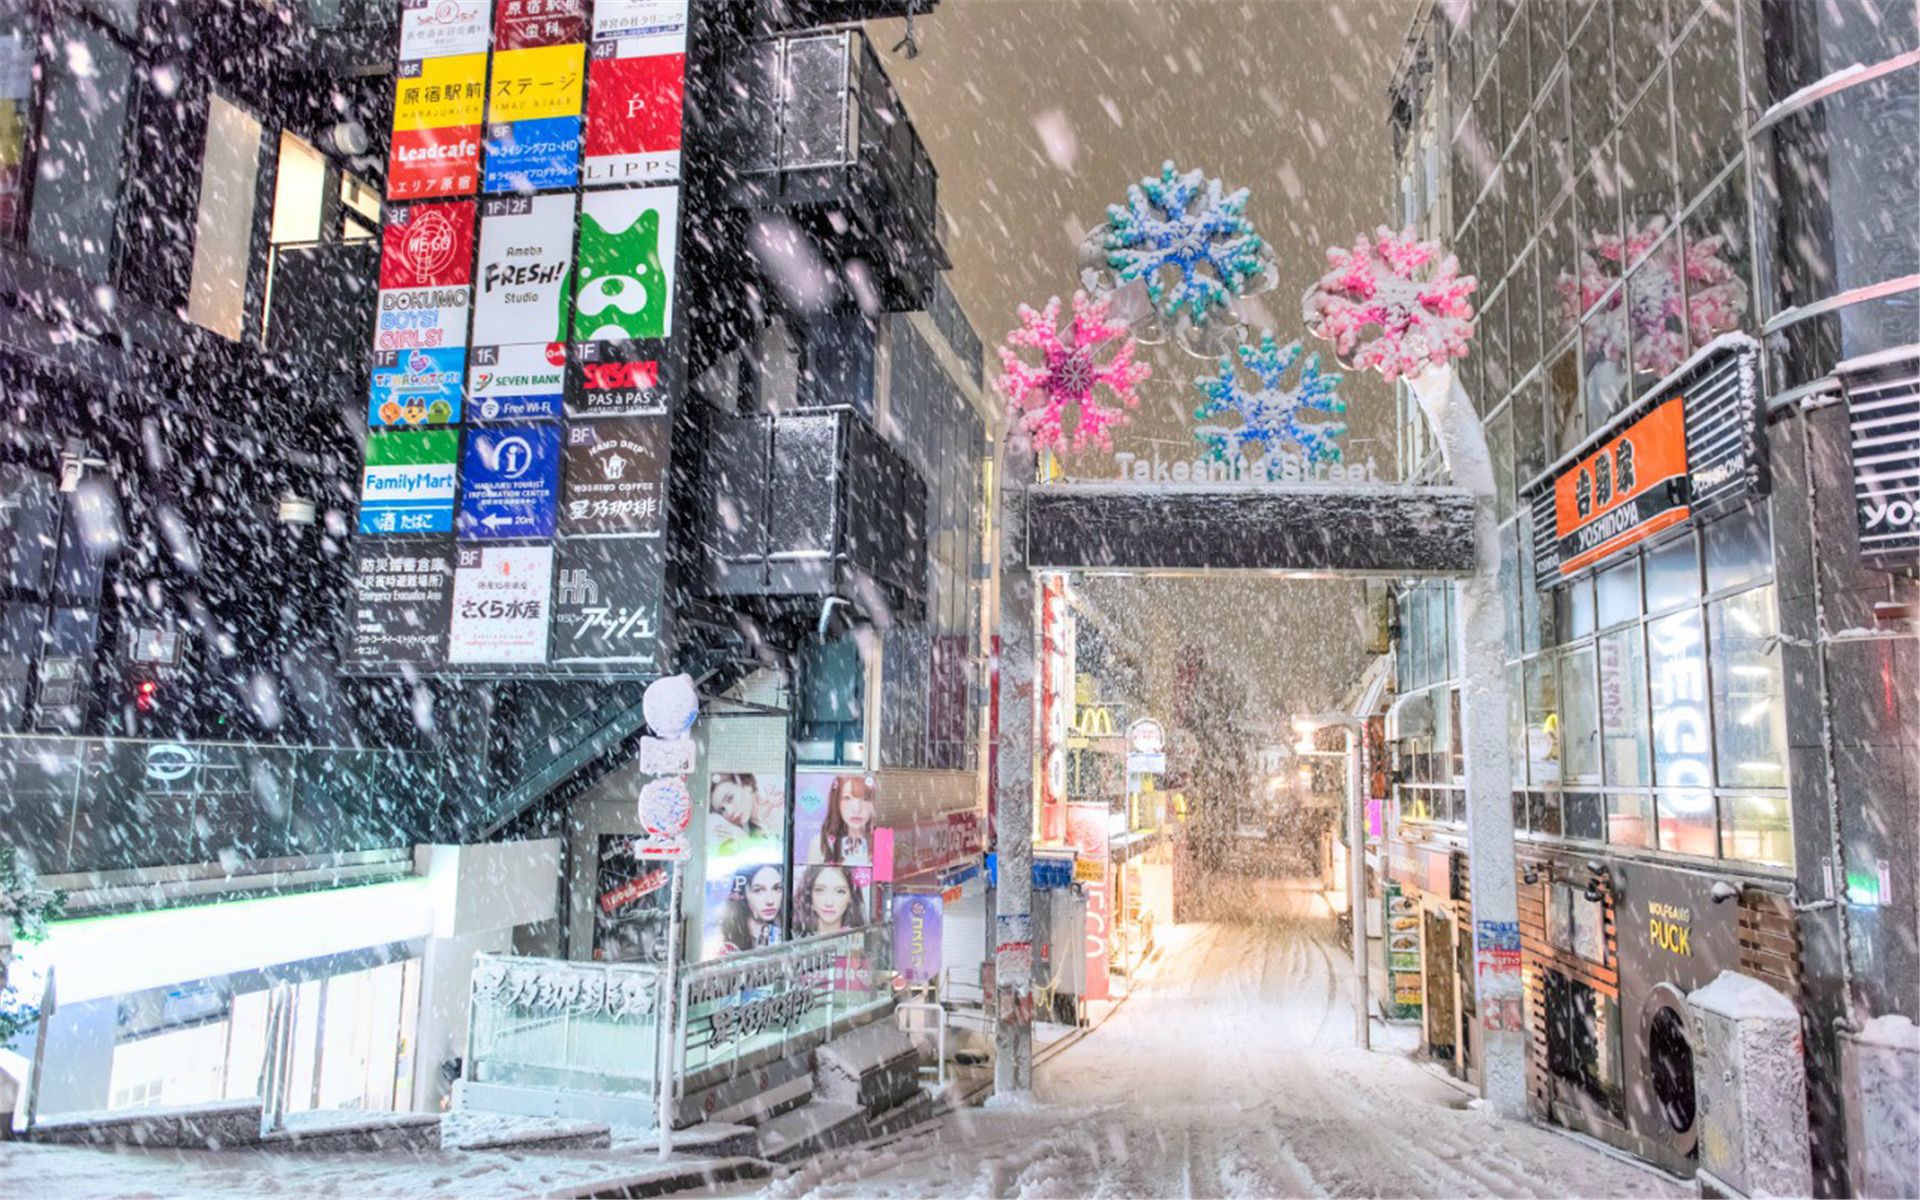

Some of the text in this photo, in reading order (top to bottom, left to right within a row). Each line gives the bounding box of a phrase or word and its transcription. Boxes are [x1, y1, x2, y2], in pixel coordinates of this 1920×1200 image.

[595, 43, 614, 58] 4F
[404, 63, 419, 76] 6F
[403, 73, 577, 105] 原宿駅前 ステージ
[398, 139, 477, 162] Leadcafe
[587, 161, 679, 179] LIPPS
[397, 174, 472, 193] エリア原宿
[487, 201, 528, 215] 1F 2F
[506, 246, 543, 256] Ameba
[485, 261, 565, 293] FRESH!
[383, 288, 468, 311] DOKUMO
[504, 292, 539, 304] Studio
[380, 309, 439, 330] BOYS!
[379, 328, 444, 349] GIRLS!
[378, 351, 397, 365] 1F
[477, 348, 494, 363] 1F
[577, 343, 595, 360] 1F
[495, 374, 560, 386] SEVEN BANK
[588, 393, 613, 405] PAS
[625, 391, 651, 404] PAS
[503, 403, 525, 414] Free
[571, 428, 590, 443] BF
[1114, 451, 1380, 484] Takeshita Street
[366, 472, 453, 493] FamilyMart
[574, 482, 654, 492] HOSHINO COFFEE
[1576, 438, 1636, 520] 吉野家
[521, 489, 550, 497] CENTER
[569, 498, 657, 521] 星乃珈琲
[379, 512, 433, 531] 酒 たばこ
[515, 516, 534, 525] 20m
[1579, 500, 1640, 551] YOSHINOYA
[461, 551, 479, 566] BF
[461, 600, 541, 619] さくら水産
[573, 605, 656, 640] アッシュ
[1653, 607, 1713, 814] WEGO
[1650, 918, 1692, 957] PUCK
